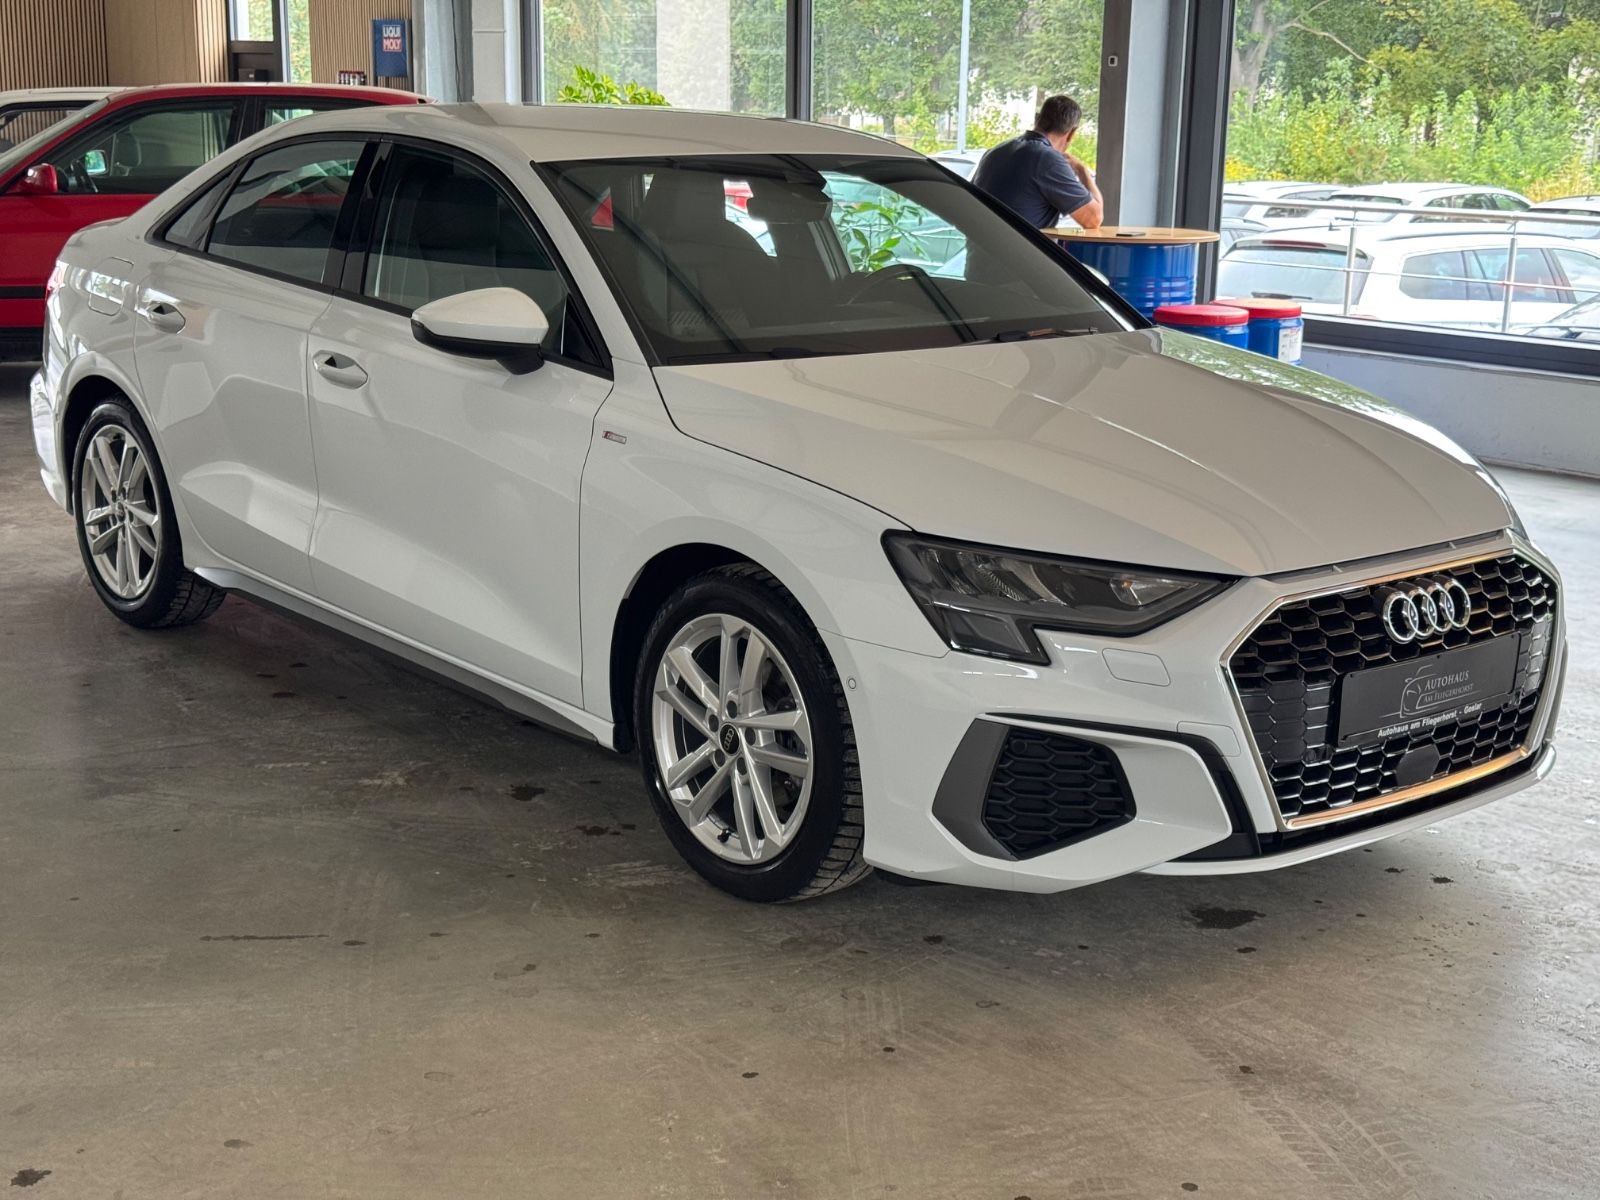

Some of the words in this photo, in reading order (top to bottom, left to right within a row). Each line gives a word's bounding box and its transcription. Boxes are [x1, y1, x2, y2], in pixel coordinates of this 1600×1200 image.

[383, 38, 402, 51] MOLY
[1424, 670, 1469, 691] AUTOHAUS
[1377, 723, 1409, 738] Autohaus
[1410, 721, 1421, 730] am
[1422, 710, 1457, 727] Fliegerhorst
